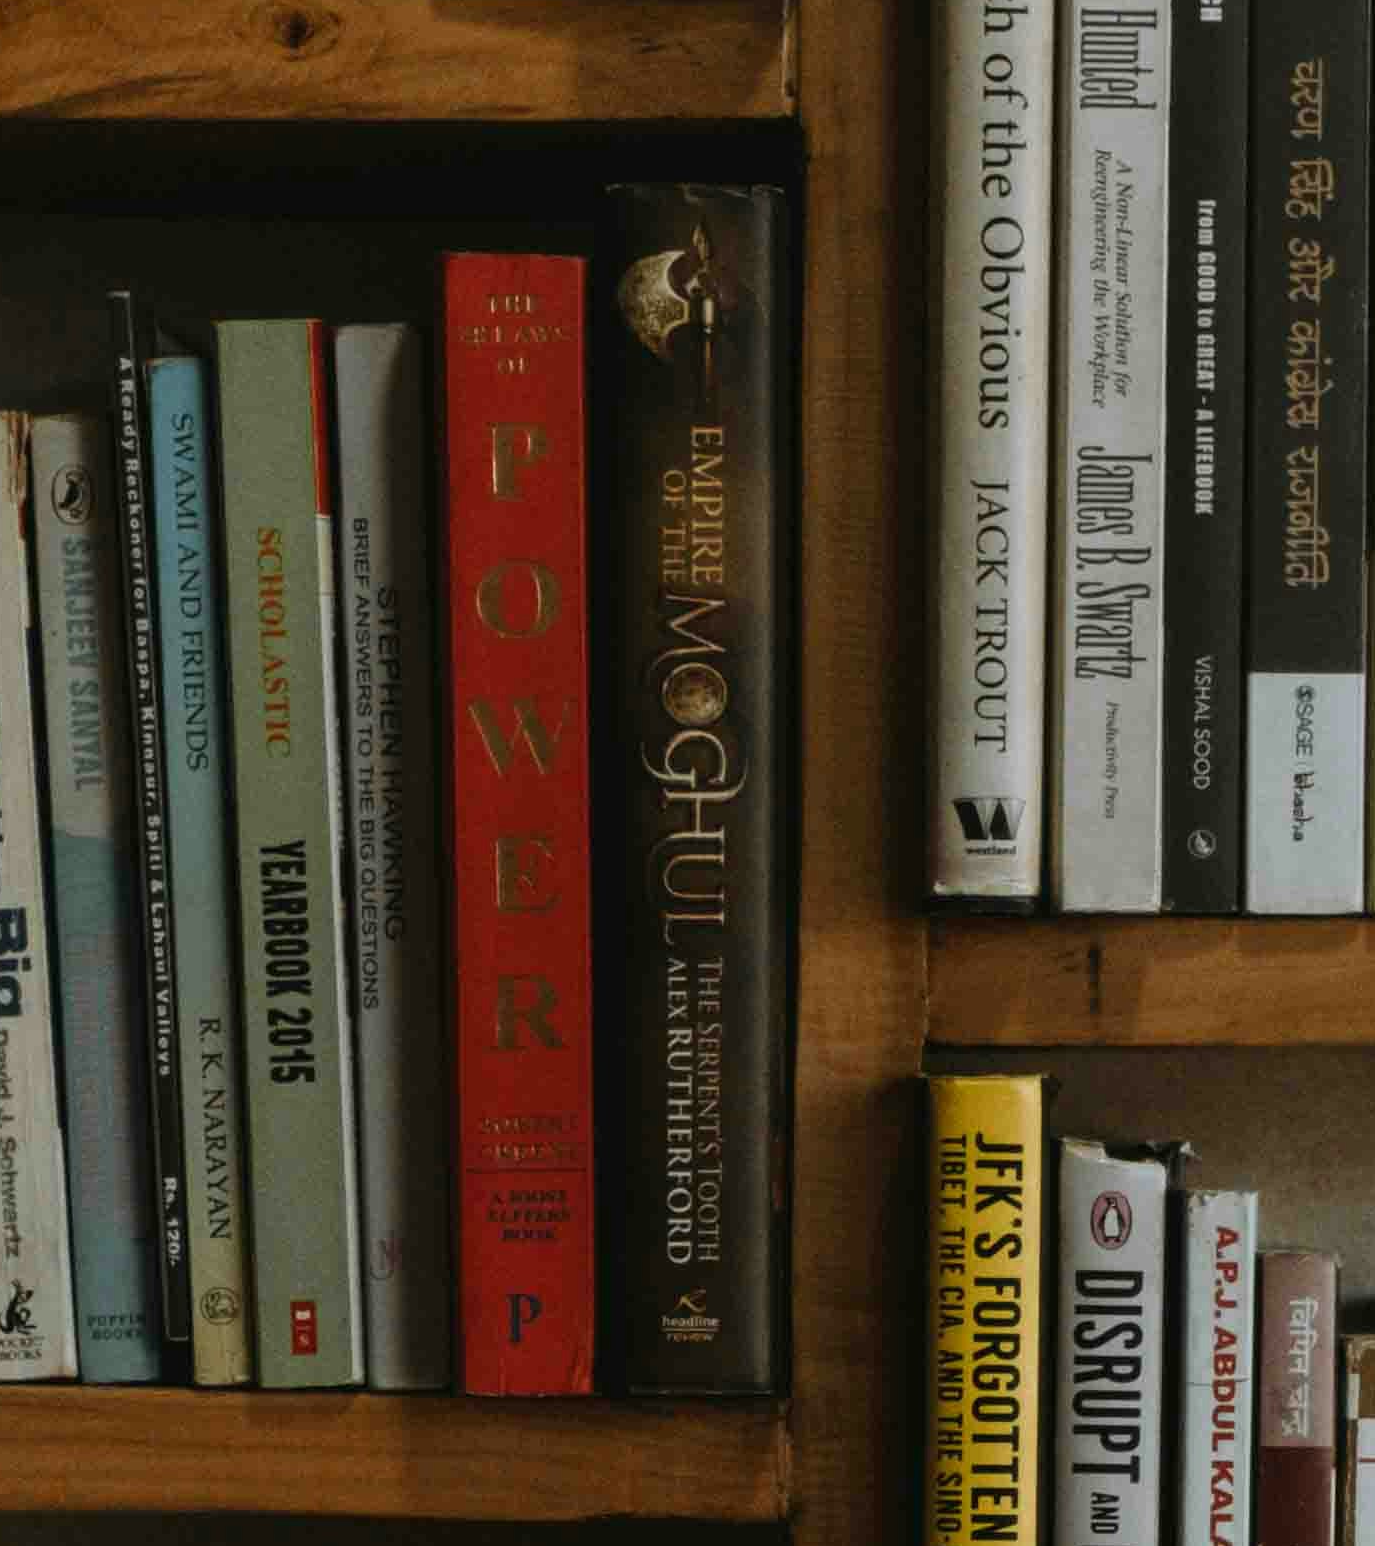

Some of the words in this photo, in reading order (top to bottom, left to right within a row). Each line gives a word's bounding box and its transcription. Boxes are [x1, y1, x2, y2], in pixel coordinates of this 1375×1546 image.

[982, 52, 1031, 109] of
[982, 117, 1026, 198] the
[116, 357, 132, 372] A
[978, 216, 1028, 430] Obvious
[118, 378, 133, 451] Ready
[123, 459, 143, 571] Reckoner
[971, 478, 1010, 585] JACK
[131, 576, 146, 612] for
[132, 618, 152, 701] Baspa,
[256, 526, 290, 758] SCHOLASTIC
[377, 586, 402, 757] STEPHEN
[972, 600, 1008, 754] TROUT
[1191, 656, 1212, 723] VISHAL
[1191, 728, 1212, 789] SOOD
[145, 814, 161, 871] Spiti
[382, 767, 409, 942] HAWKING
[149, 879, 165, 894] &
[259, 839, 306, 1000] YEARBOOK
[149, 900, 166, 982] Lahaul
[665, 957, 690, 1020] ALEX
[153, 989, 171, 1075] Valleys
[265, 1006, 314, 1085] 2015
[665, 1027, 692, 1265] RUTHERFORD
[973, 1133, 1019, 1260] JFK'S
[971, 1275, 1019, 1544] FORGOTTEN
[1070, 1268, 1143, 1482] DISRUPT
[1090, 1492, 1118, 1535] AND
